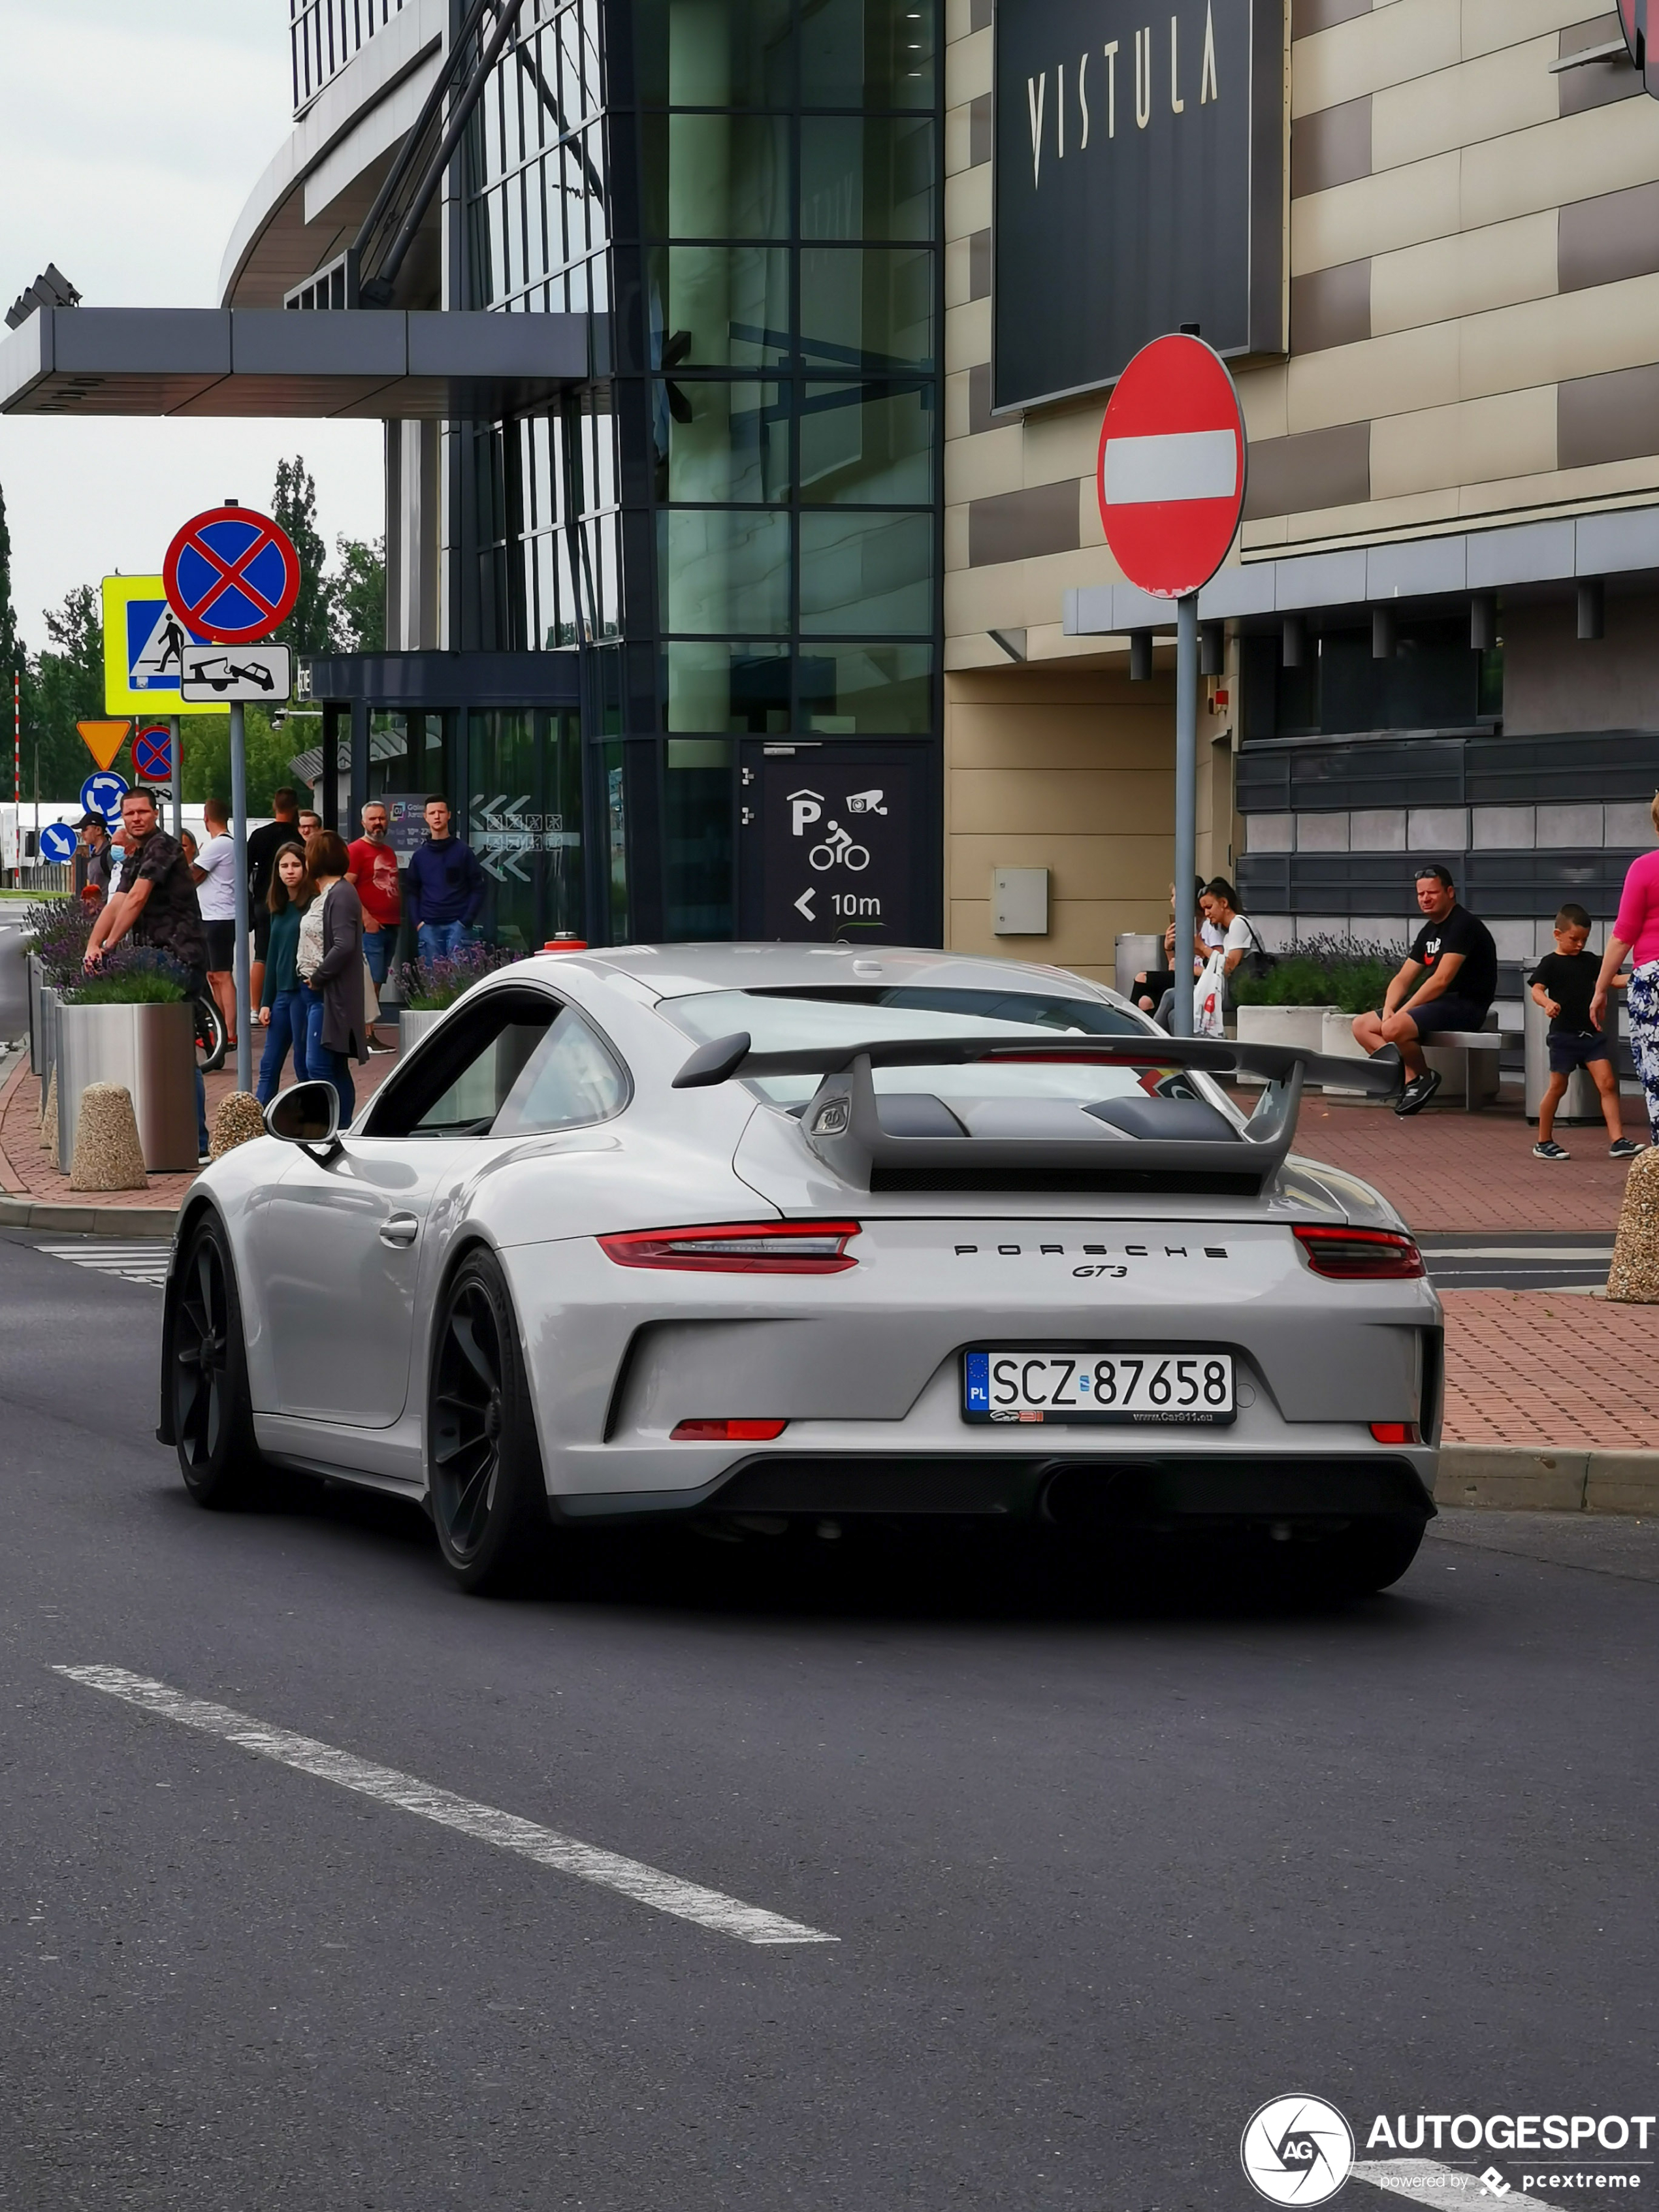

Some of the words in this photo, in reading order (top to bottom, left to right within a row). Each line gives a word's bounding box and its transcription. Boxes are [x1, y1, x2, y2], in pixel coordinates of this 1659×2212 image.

[1027, 0, 1217, 190] VISTULA
[792, 800, 821, 836] P
[831, 893, 880, 916] 10m
[954, 1244, 1229, 1258] PORSCHE
[1072, 1265, 1127, 1277] GT3
[971, 1388, 987, 1400] PL
[993, 1360, 1076, 1405] SCZ
[1093, 1360, 1226, 1405] 87658
